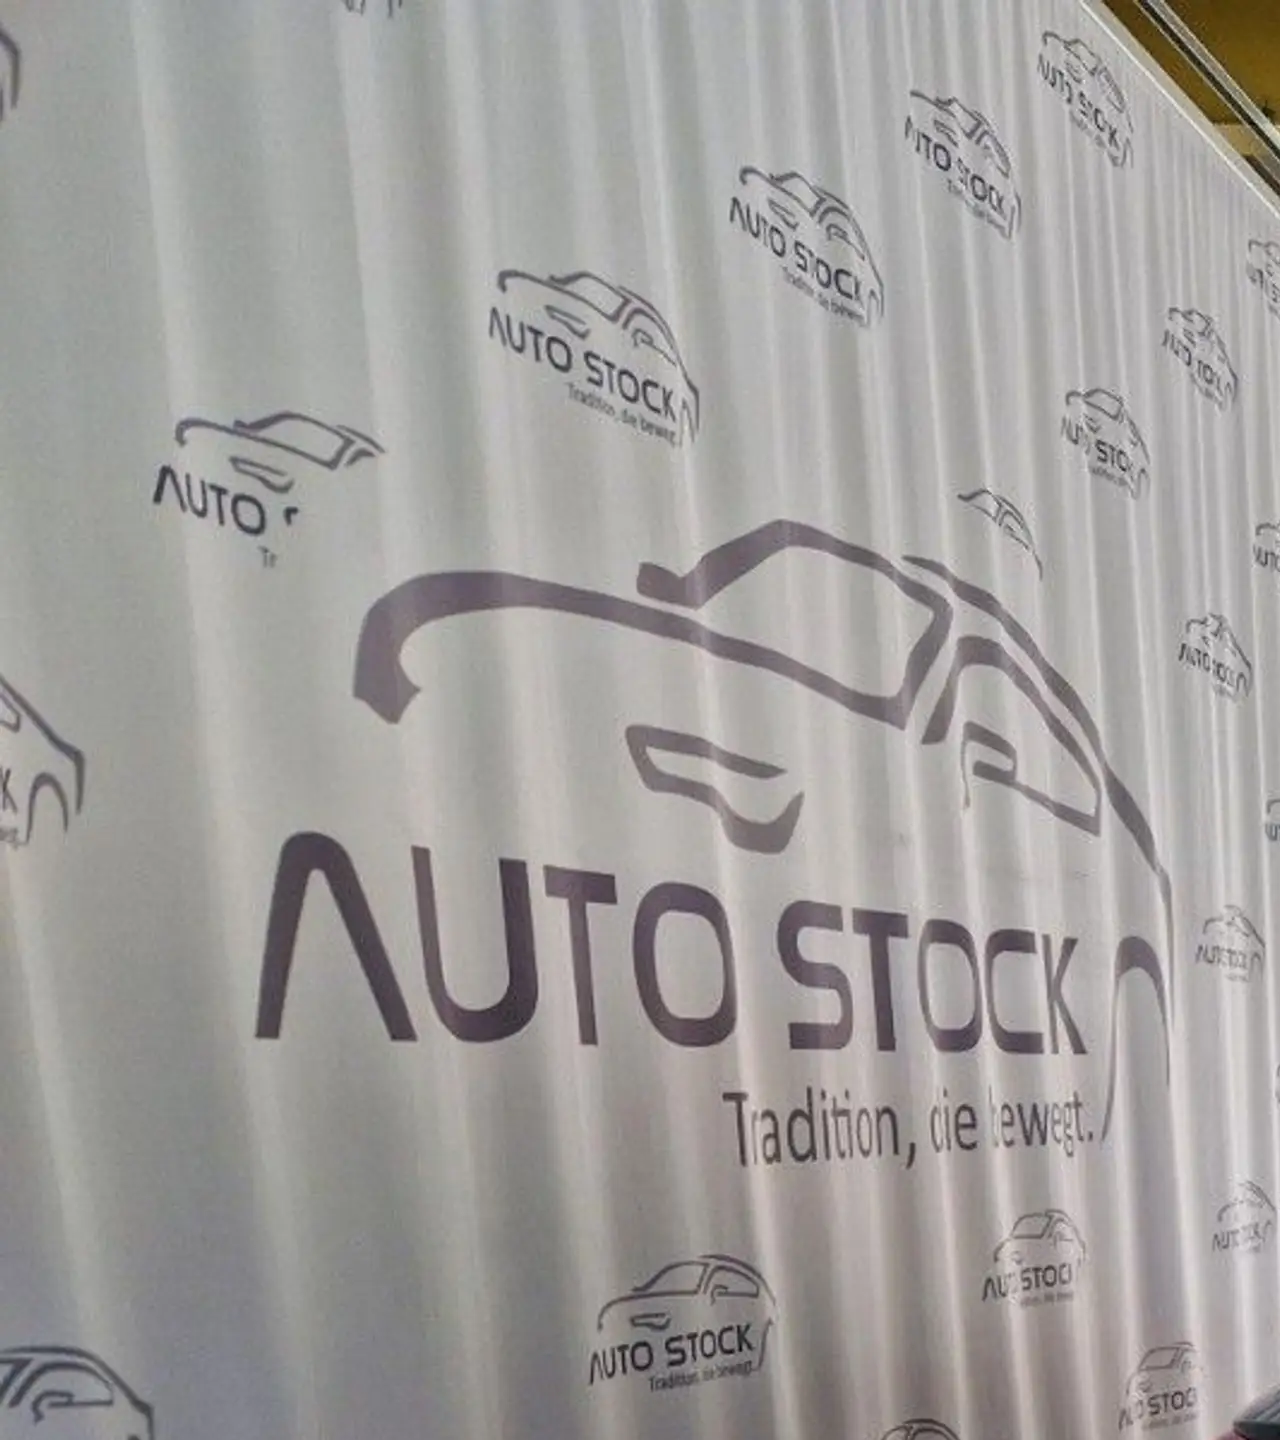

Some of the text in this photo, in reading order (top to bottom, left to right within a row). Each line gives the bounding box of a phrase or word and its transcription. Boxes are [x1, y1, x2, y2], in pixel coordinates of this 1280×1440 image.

[489, 306, 677, 423] AUTO STOCK
[153, 464, 267, 537] AUTO
[255, 831, 1088, 1055] AUTO STOCK
[721, 1085, 918, 1169] Tradition,
[590, 1341, 653, 1386] AUTO
[665, 1324, 755, 1367] STOCK
